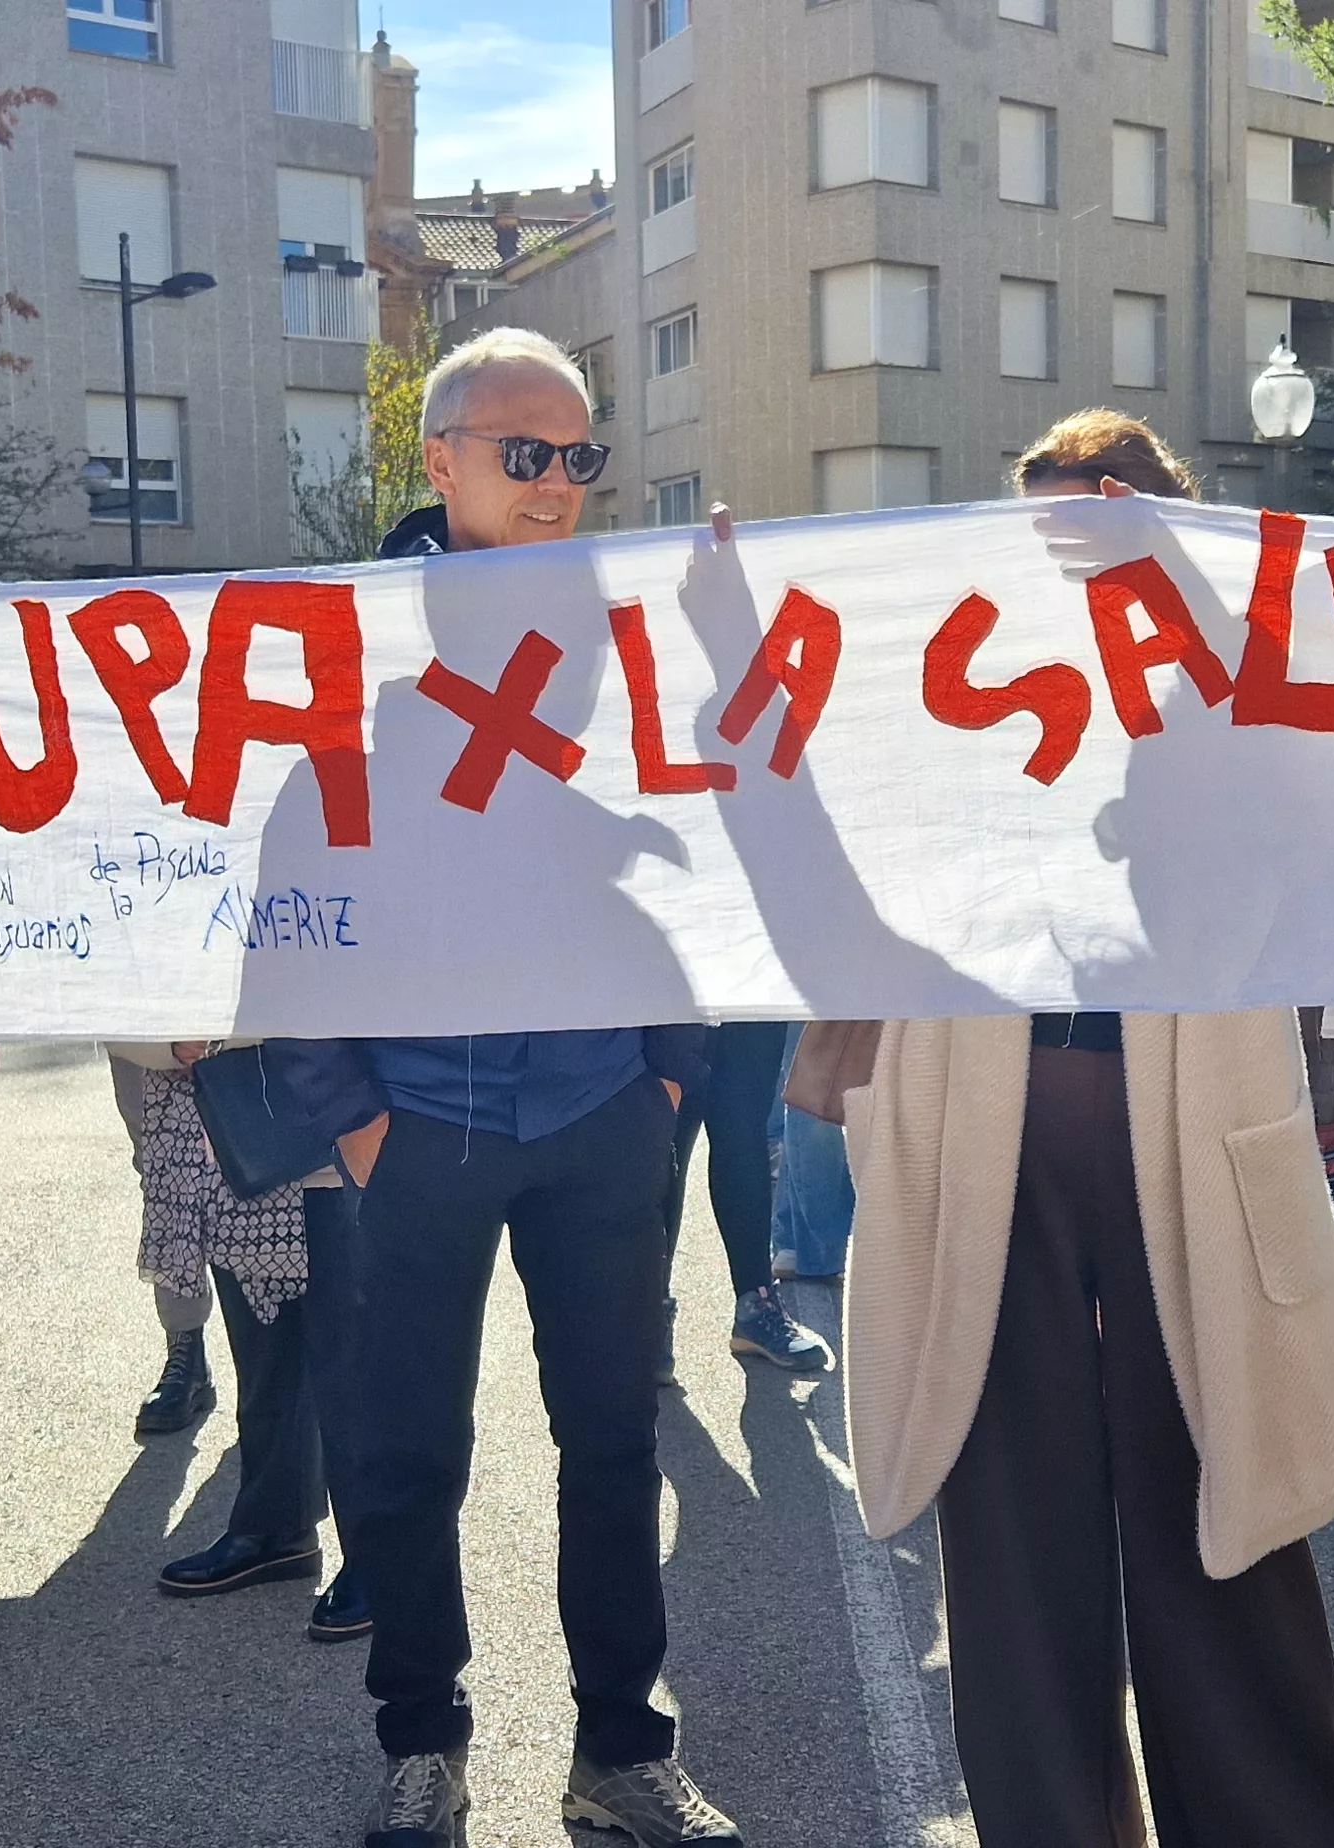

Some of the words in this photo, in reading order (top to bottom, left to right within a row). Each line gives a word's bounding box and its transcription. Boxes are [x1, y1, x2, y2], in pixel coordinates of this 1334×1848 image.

[608, 580, 842, 795] LA
[90, 831, 122, 884] de
[109, 885, 133, 921] la
